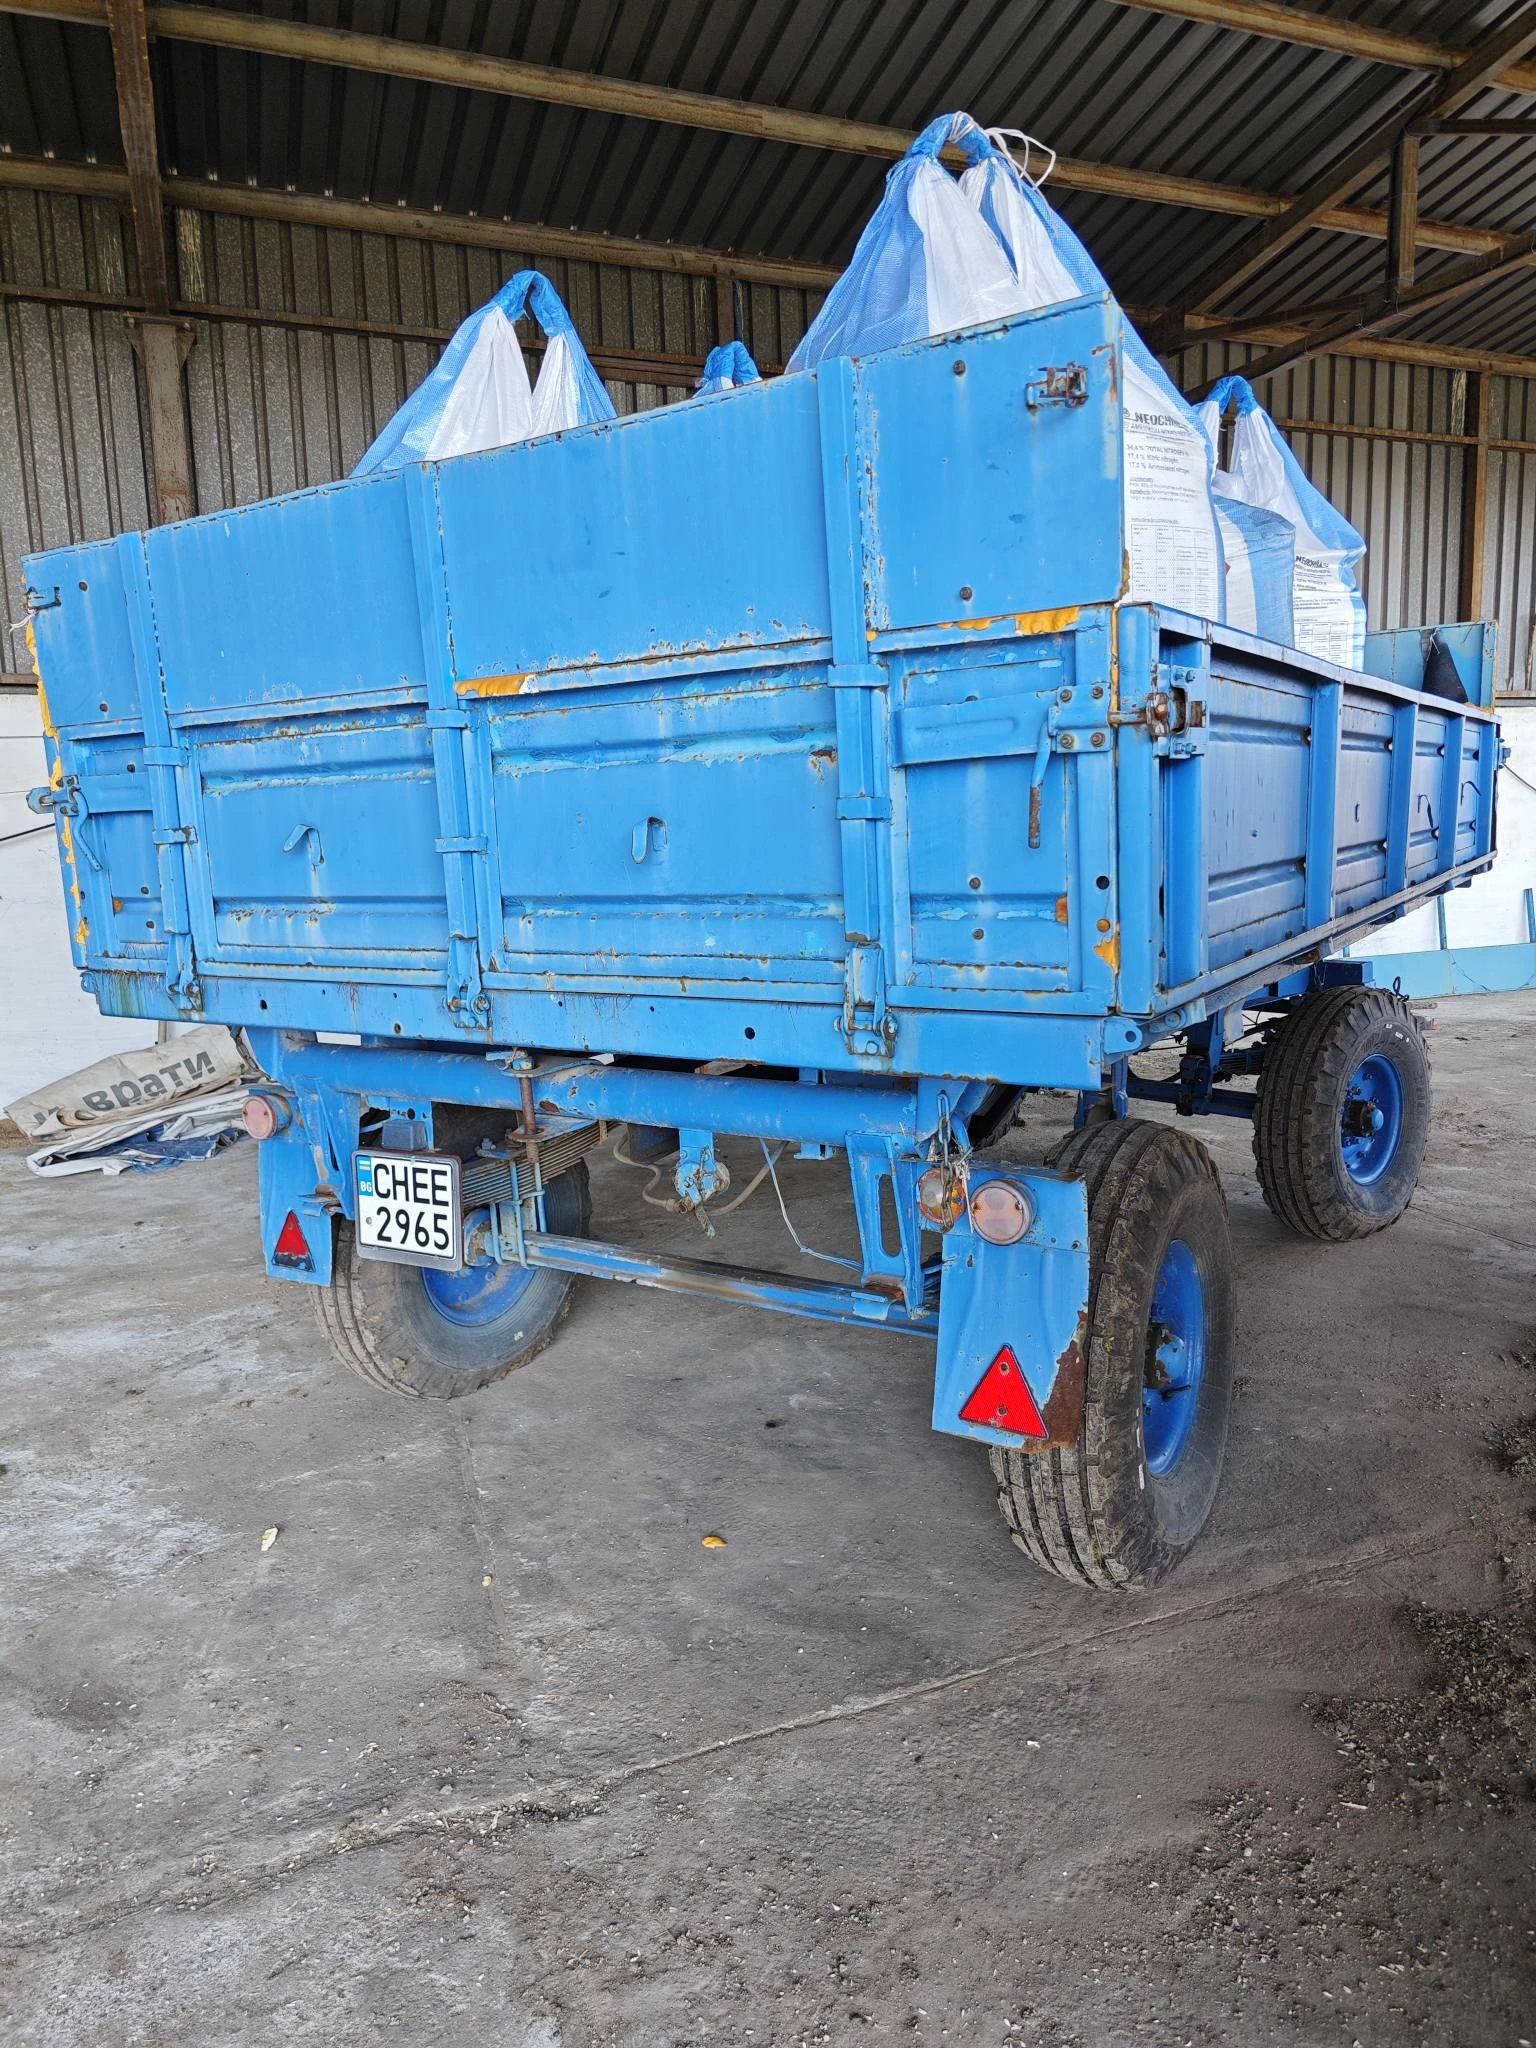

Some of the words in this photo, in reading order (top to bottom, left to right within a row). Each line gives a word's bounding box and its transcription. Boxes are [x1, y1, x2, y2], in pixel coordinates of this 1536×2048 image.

[82, 1051, 217, 1112] врати
[360, 1181, 373, 1193] BG
[374, 1163, 449, 1207] CHEE
[376, 1206, 450, 1251] 2965
